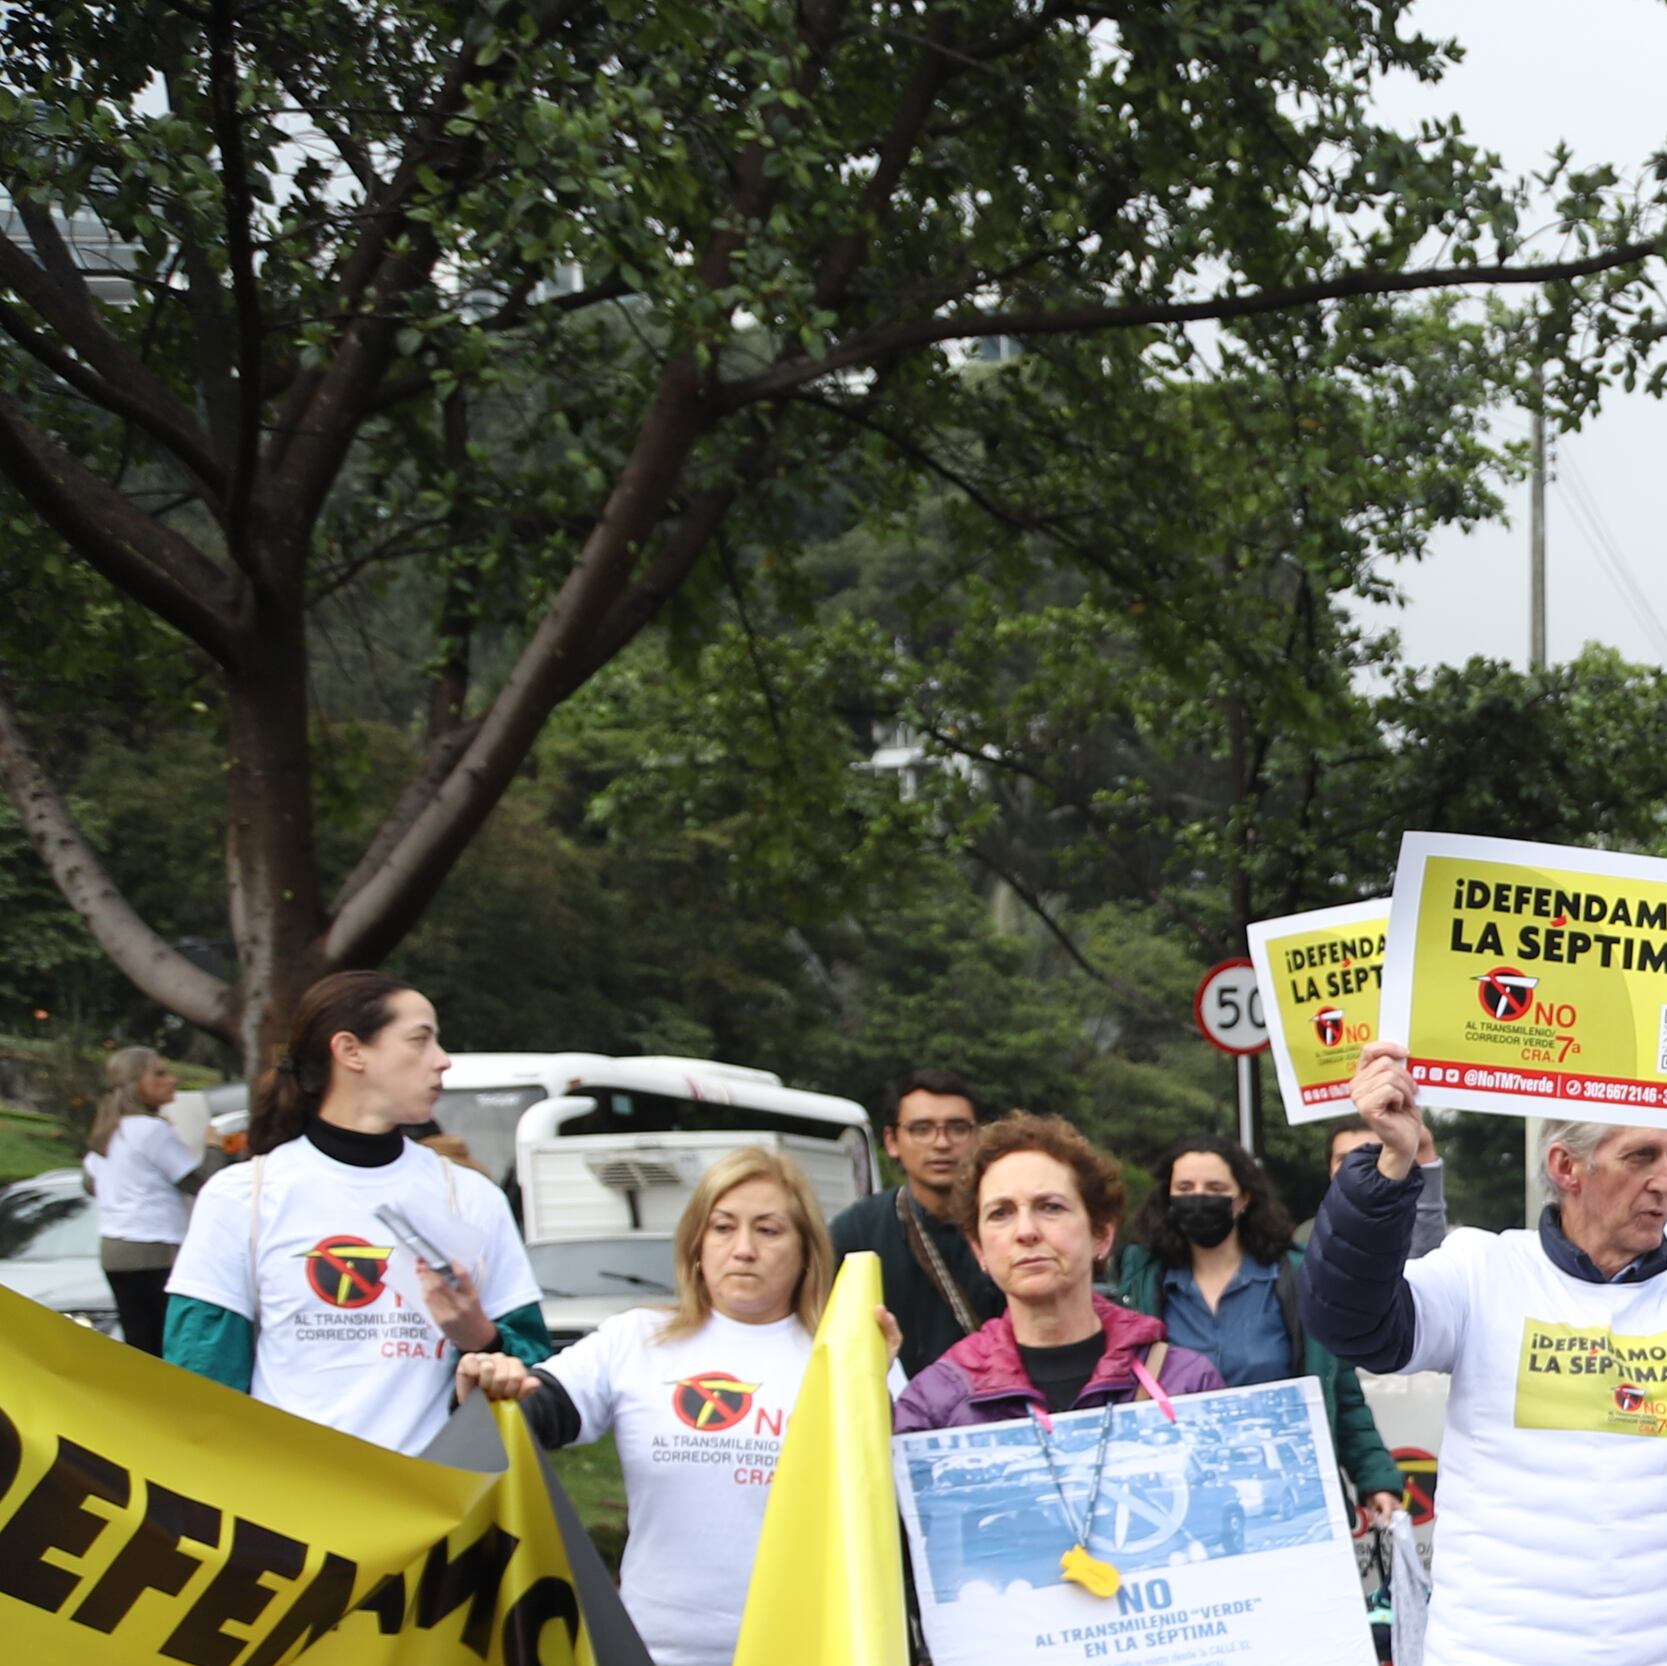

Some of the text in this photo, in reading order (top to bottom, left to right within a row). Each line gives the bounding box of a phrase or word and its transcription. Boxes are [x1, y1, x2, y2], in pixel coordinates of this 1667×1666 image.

[1450, 918, 1504, 956] LA
[1291, 978, 1320, 1004] LA
[1466, 1021, 1478, 1031] AL
[1534, 1002, 1576, 1028] NO
[1346, 1022, 1370, 1043] NO
[1465, 1032, 1554, 1049] CORREDOR VERDE
[1464, 1069, 1554, 1093] @NoTM7verde
[296, 1327, 429, 1341] CORREDOR VERDE
[1529, 1354, 1561, 1374] LA
[1644, 1402, 1667, 1414] NO
[755, 1408, 792, 1437] N
[652, 1436, 669, 1448] AL
[652, 1451, 732, 1464] CORREDOR
[1117, 1578, 1173, 1616] NO
[1035, 1633, 1056, 1649] AL
[1061, 1611, 1188, 1644] TRANSMILENIO
[1085, 1641, 1108, 1658] EN
[1116, 1637, 1139, 1653] LA
[1145, 1617, 1228, 1648] SÉPTIMA
